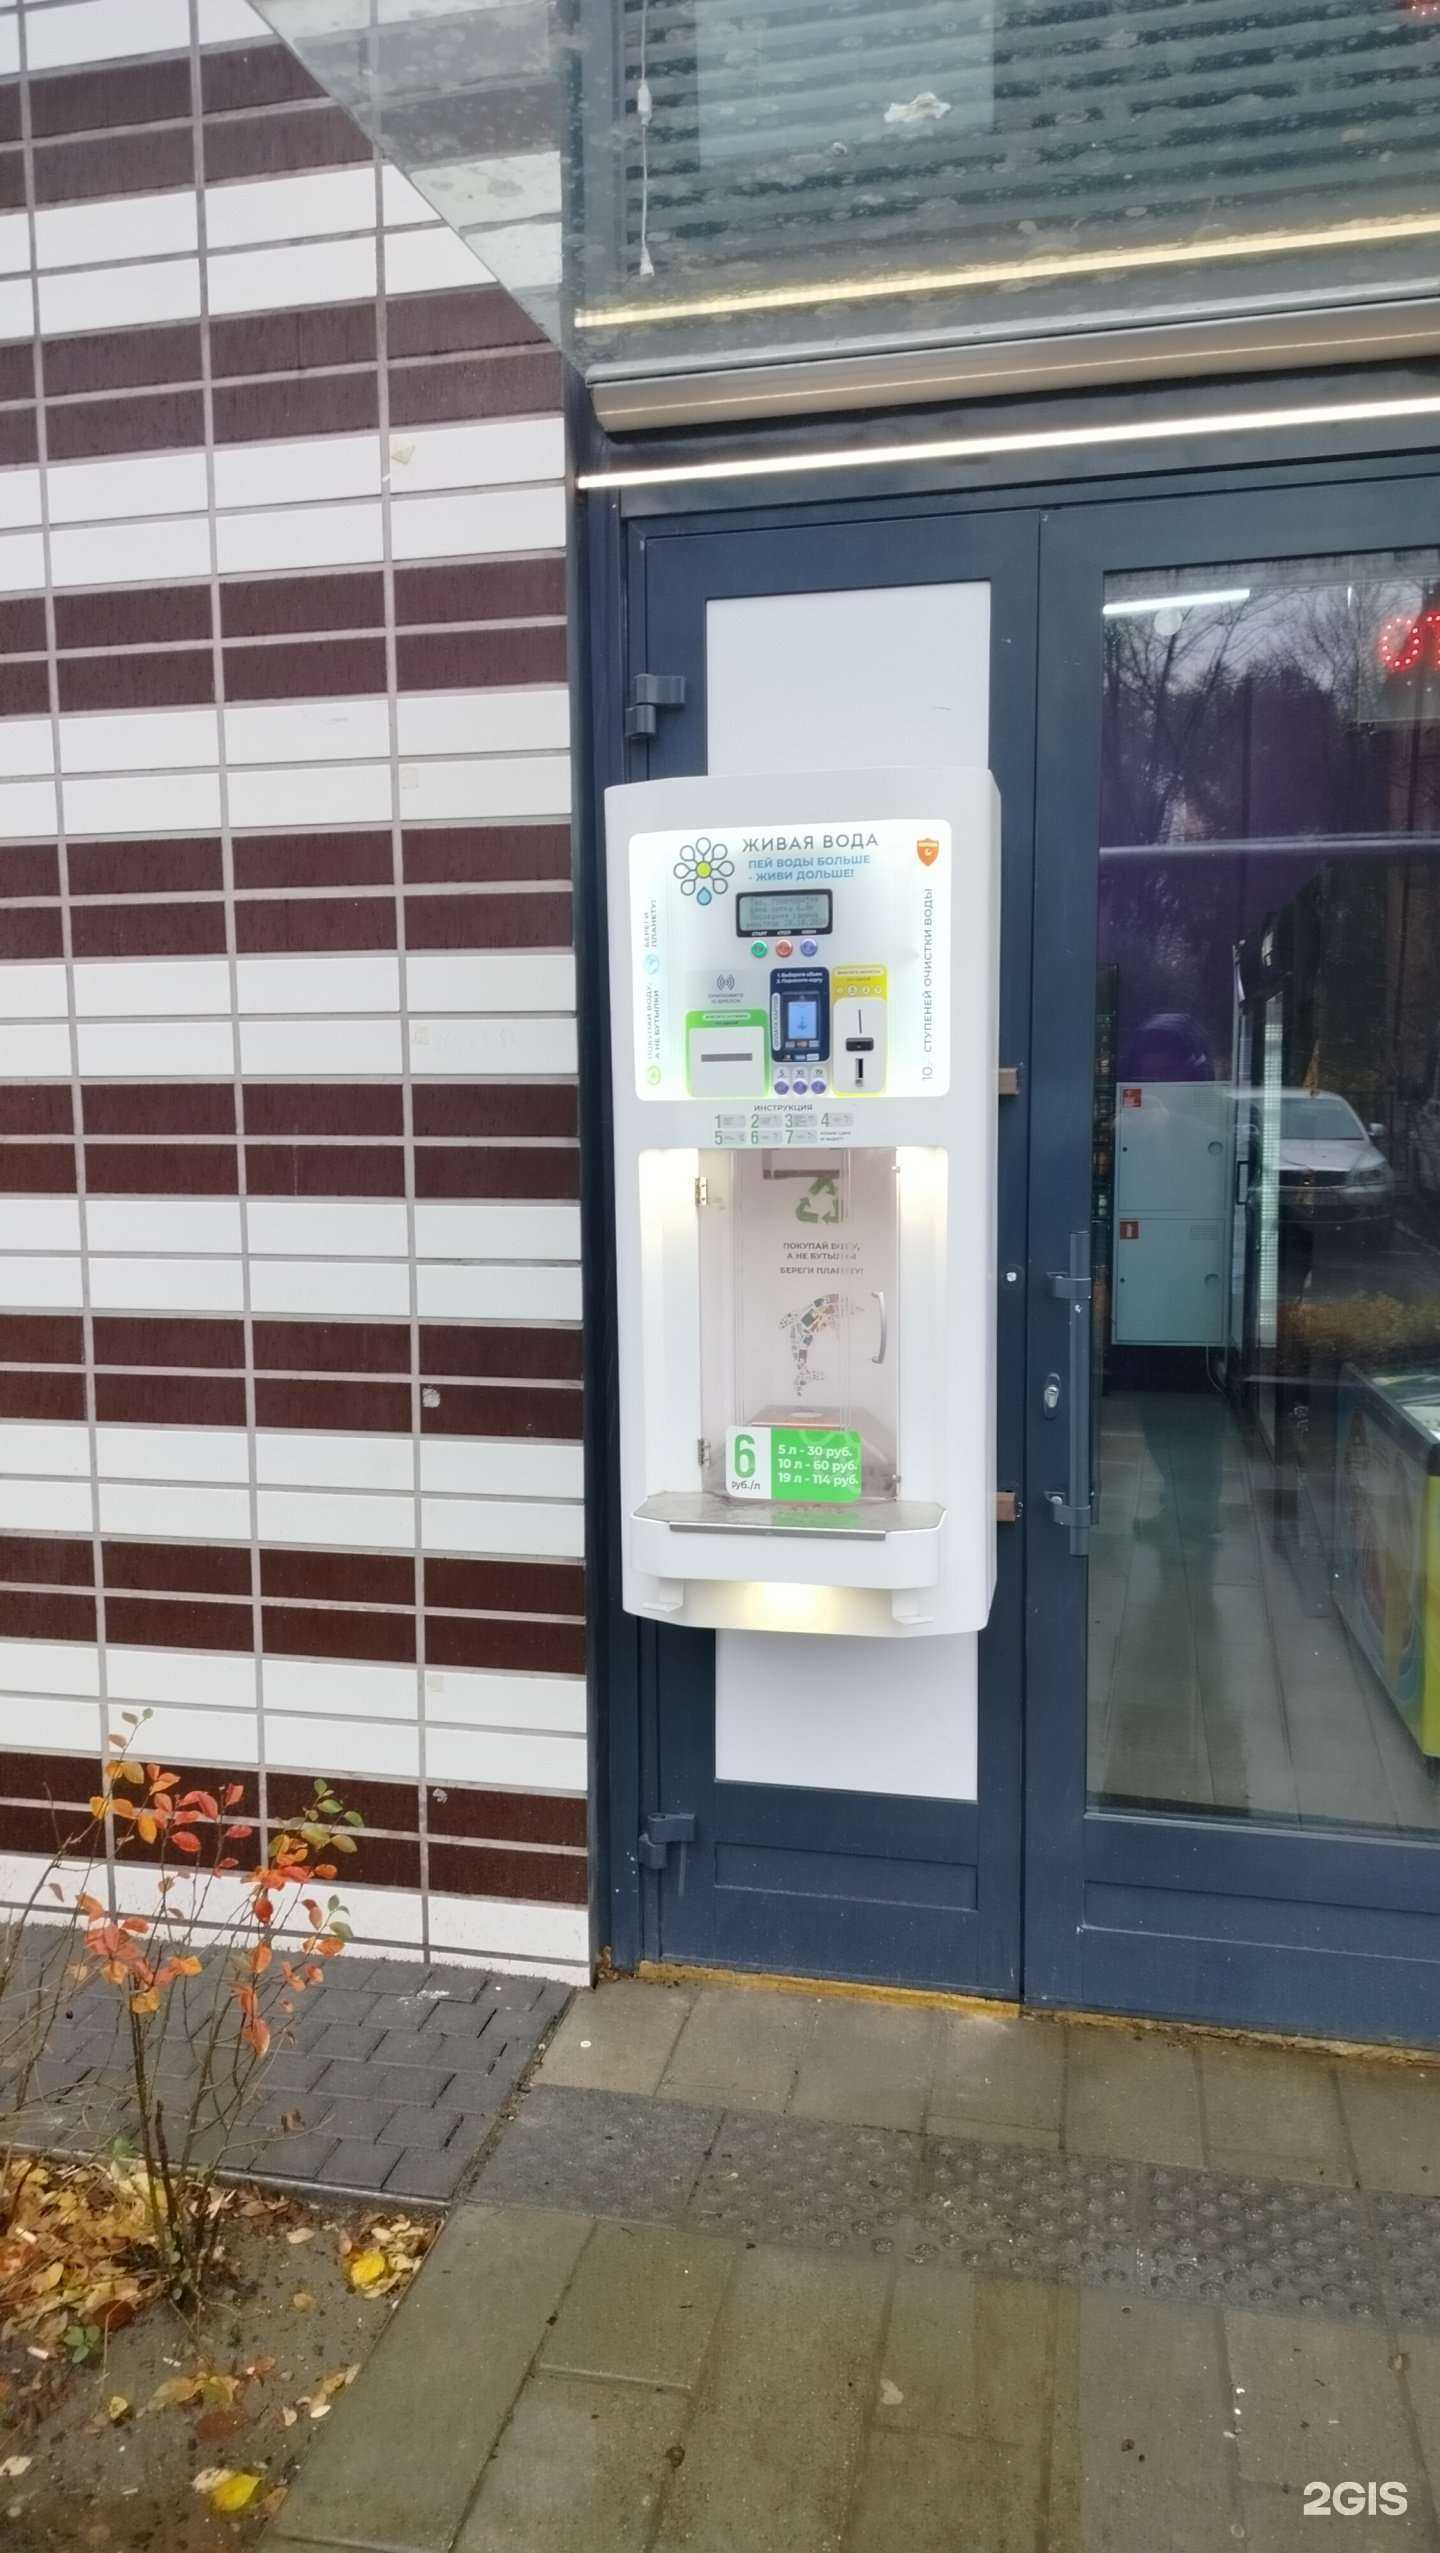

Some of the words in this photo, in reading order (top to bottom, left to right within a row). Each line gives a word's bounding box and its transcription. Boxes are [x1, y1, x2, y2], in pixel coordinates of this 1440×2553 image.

[742, 836, 814, 852] ЖИВАЯ
[824, 833, 879, 849] ВОДА
[748, 857, 773, 869] ПЕЙ
[777, 857, 814, 868] ВОДЫ
[817, 855, 870, 866] БОЛЬШЕ
[756, 871, 793, 881] ЖИВИ
[797, 869, 854, 881] ДОЛЬШЕ!
[924, 888, 933, 926] ВОДЫ
[923, 929, 933, 987] ОЧИСТКИ
[922, 991, 933, 1053] СТУПЕНЕЙ
[753, 1104, 813, 1112] ИНСТРУКЦИЯ
[714, 1114, 721, 1129] 1
[751, 1113, 760, 1129] 2
[784, 1113, 793, 1128] 3
[820, 1112, 831, 1127] 4
[714, 1130, 723, 1145] 5
[751, 1130, 760, 1145] 6
[785, 1130, 794, 1144] 7
[783, 1242, 829, 1250] ПОКУПАЙ
[780, 1266, 814, 1274] БЕРЕГИ
[734, 1434, 756, 1478] 6
[778, 1445, 786, 1455] 5
[787, 1447, 796, 1455] л
[808, 1446, 823, 1456] 30
[826, 1447, 852, 1458] руб.
[778, 1459, 791, 1469] 10
[813, 1461, 829, 1471] 60
[832, 1461, 858, 1473] руб.
[731, 1480, 760, 1490] руб./л
[778, 1473, 791, 1483] 19
[793, 1476, 802, 1484] л
[813, 1474, 831, 1485] 114
[834, 1475, 859, 1488] руб.
